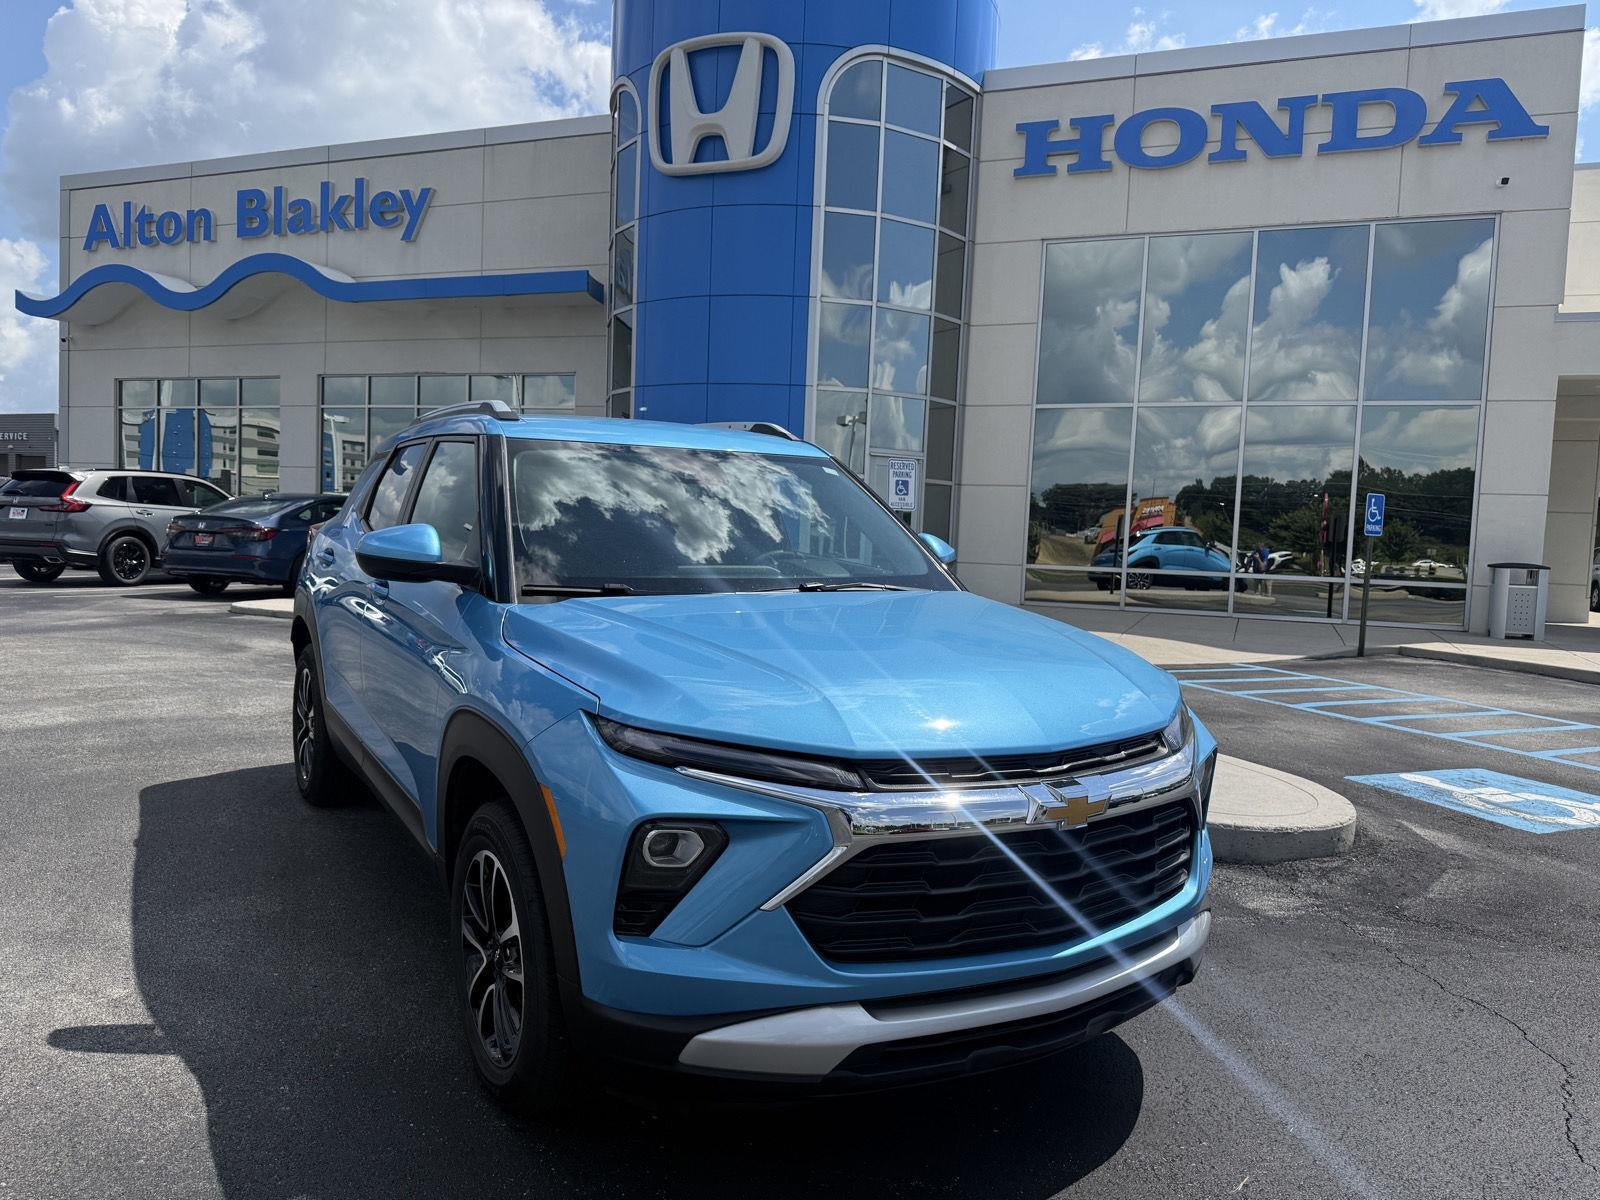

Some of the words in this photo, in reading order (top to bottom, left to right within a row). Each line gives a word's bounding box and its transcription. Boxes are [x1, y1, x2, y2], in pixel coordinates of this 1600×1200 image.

[1013, 78, 1550, 178] HONDA
[83, 201, 216, 250] Alton
[236, 177, 434, 241] Blakley
[890, 462, 914, 470] RESERVED
